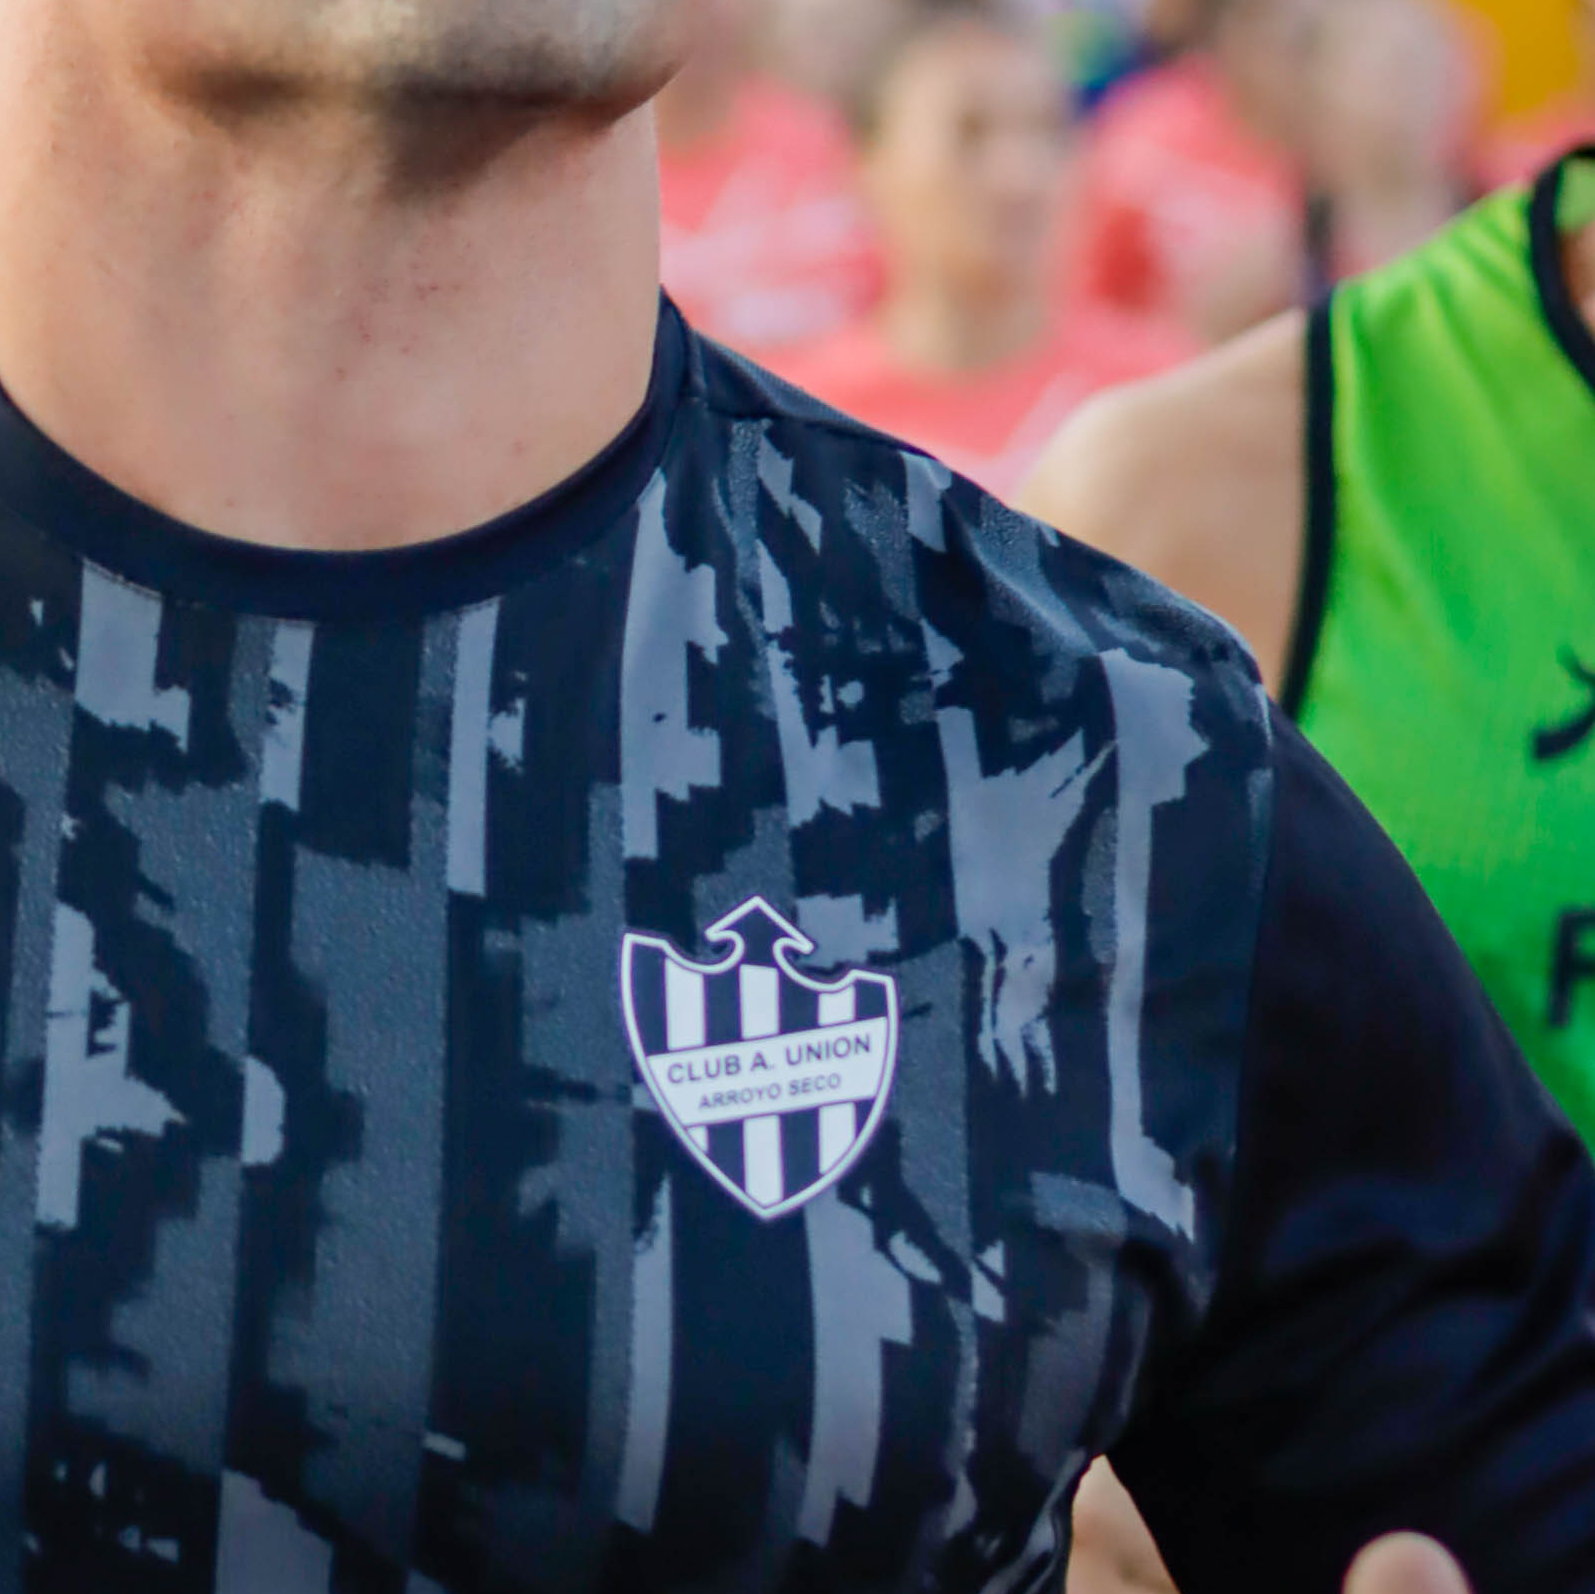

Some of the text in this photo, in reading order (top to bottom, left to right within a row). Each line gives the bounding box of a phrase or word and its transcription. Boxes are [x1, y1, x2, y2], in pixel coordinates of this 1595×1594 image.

[666, 1033, 872, 1085] CLUB A. UNION
[697, 1072, 843, 1111] ARROYO SECO
